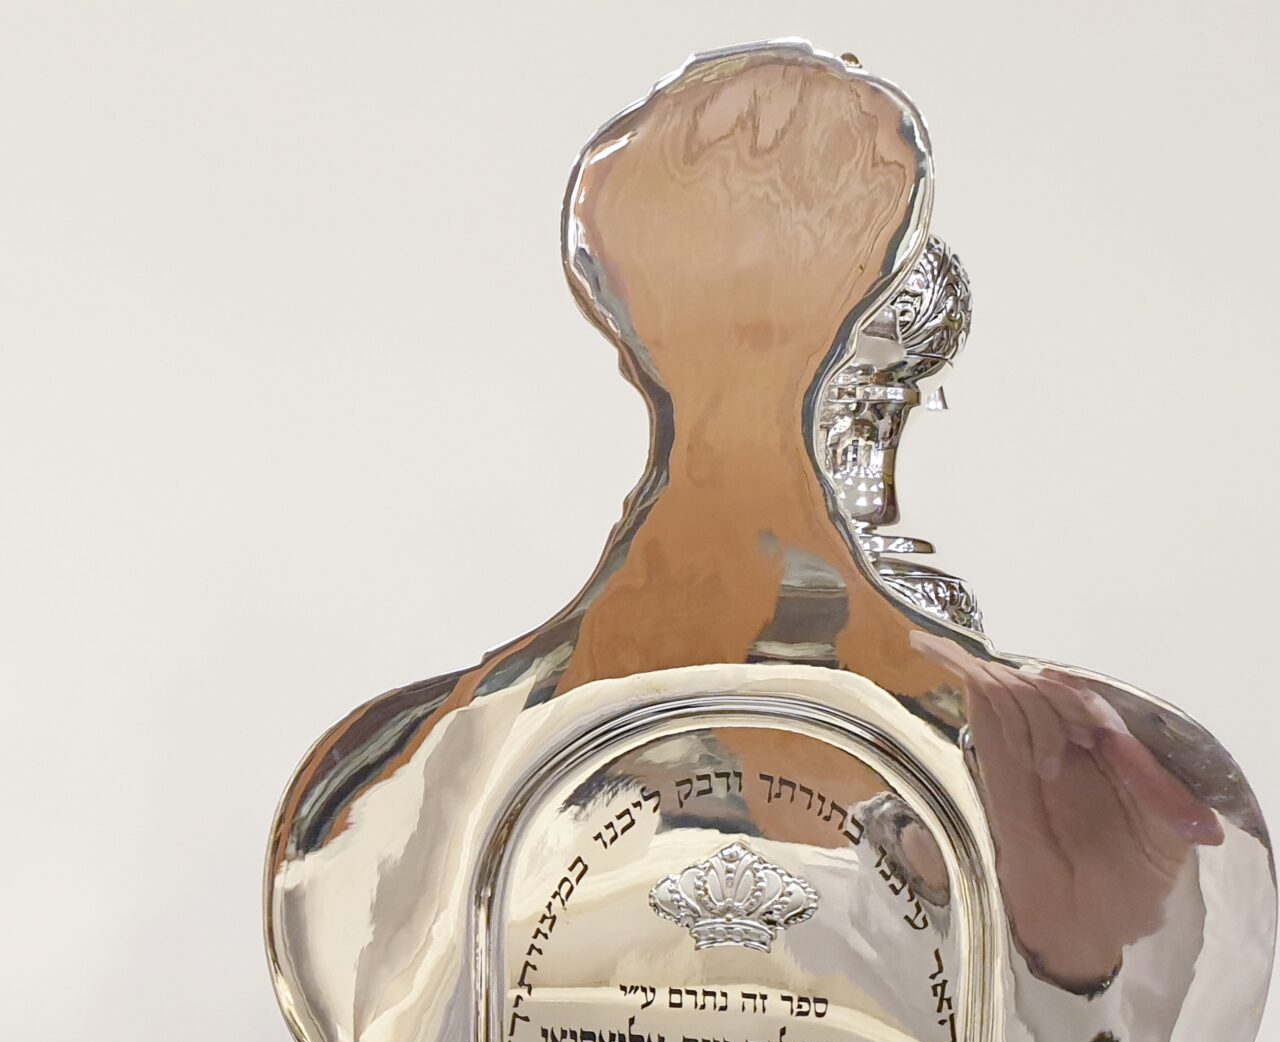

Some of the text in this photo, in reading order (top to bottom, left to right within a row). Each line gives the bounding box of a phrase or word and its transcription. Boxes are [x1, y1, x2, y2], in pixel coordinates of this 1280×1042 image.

[675, 771, 743, 808] ודבק
[759, 773, 864, 845] בתורתך
[592, 786, 661, 849] ליבנו
[619, 984, 830, 1018] ספר זה נתרם ע"י
